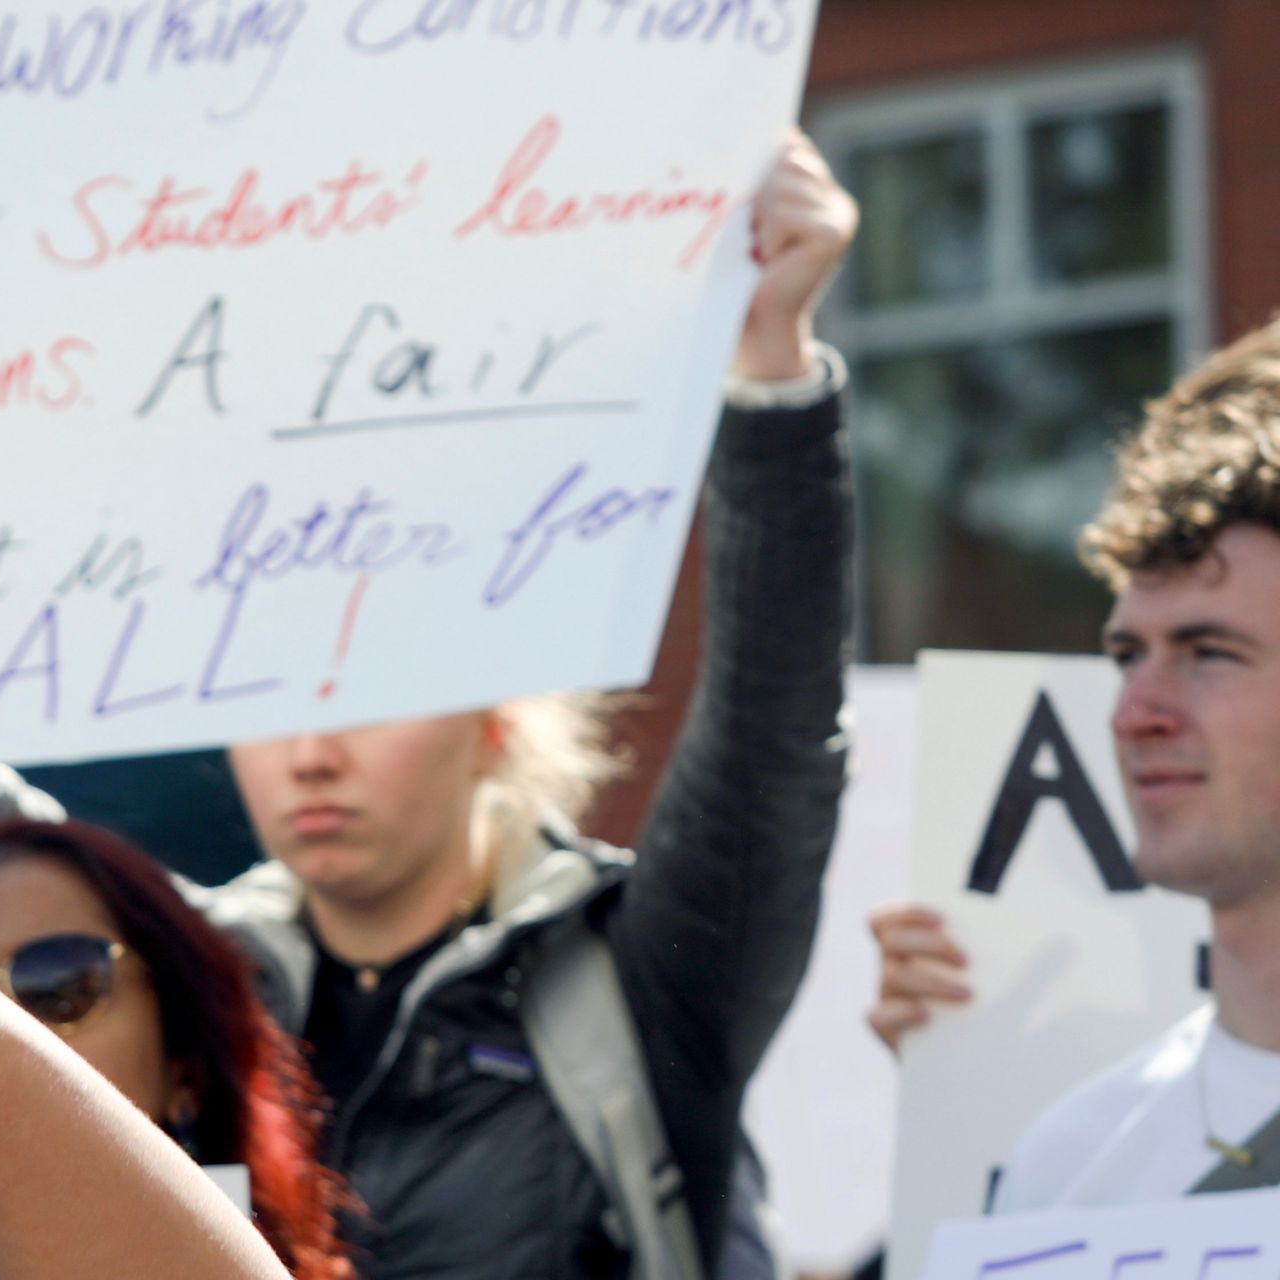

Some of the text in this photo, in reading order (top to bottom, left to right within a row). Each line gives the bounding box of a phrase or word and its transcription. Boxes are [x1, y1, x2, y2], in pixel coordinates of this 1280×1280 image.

[452, 112, 732, 270] learning
[134, 295, 229, 419] A
[306, 302, 600, 425] fair
[52, 508, 166, 600] is
[190, 482, 470, 592] better
[482, 461, 677, 608] for
